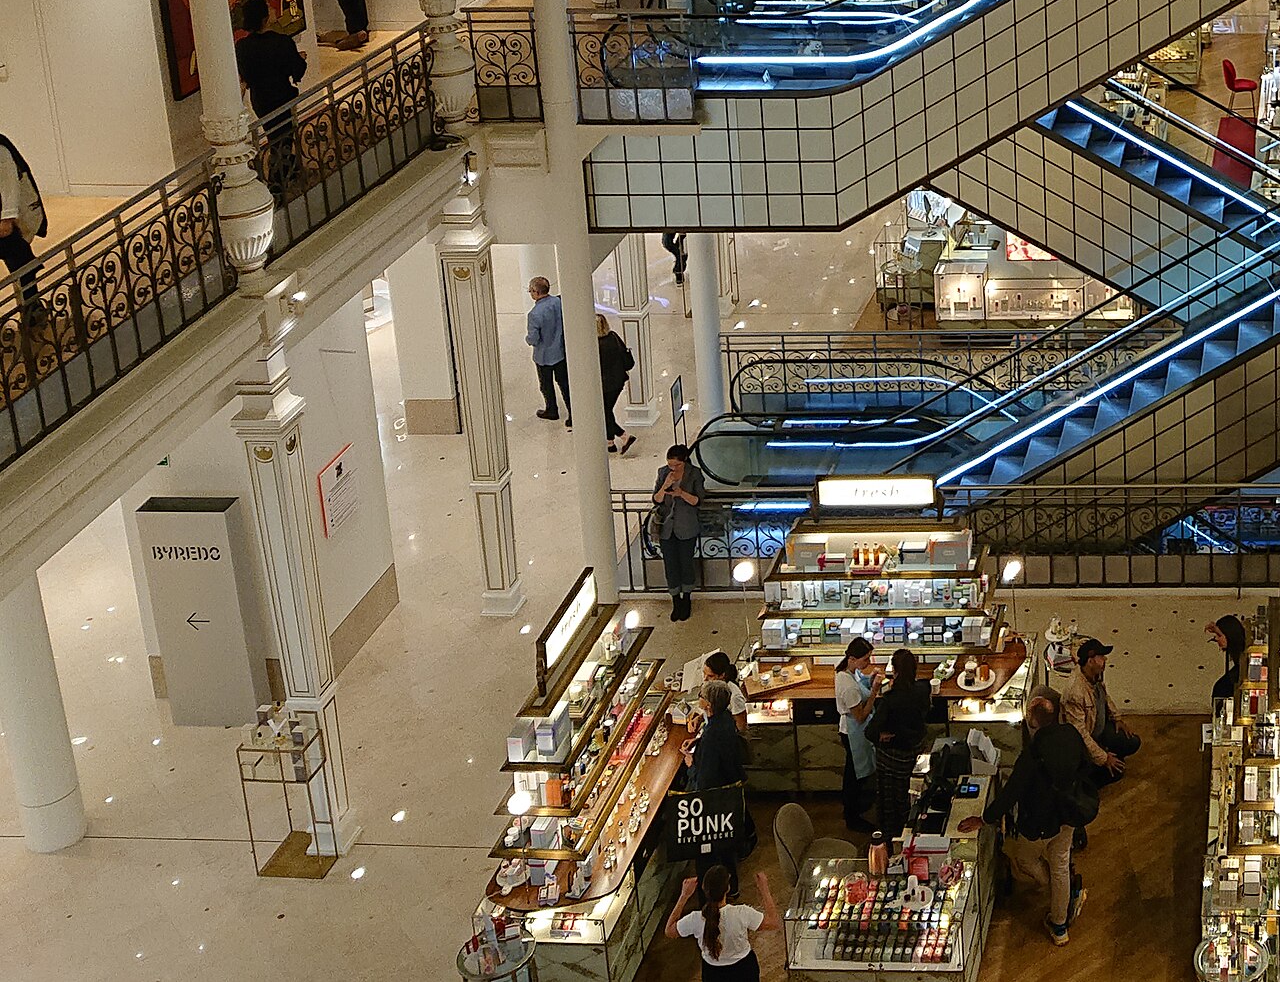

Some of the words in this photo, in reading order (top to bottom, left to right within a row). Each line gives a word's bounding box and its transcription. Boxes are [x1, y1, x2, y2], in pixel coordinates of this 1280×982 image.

[152, 546, 221, 561] BYREDO
[677, 798, 704, 818] SO
[677, 812, 734, 838] PUNK
